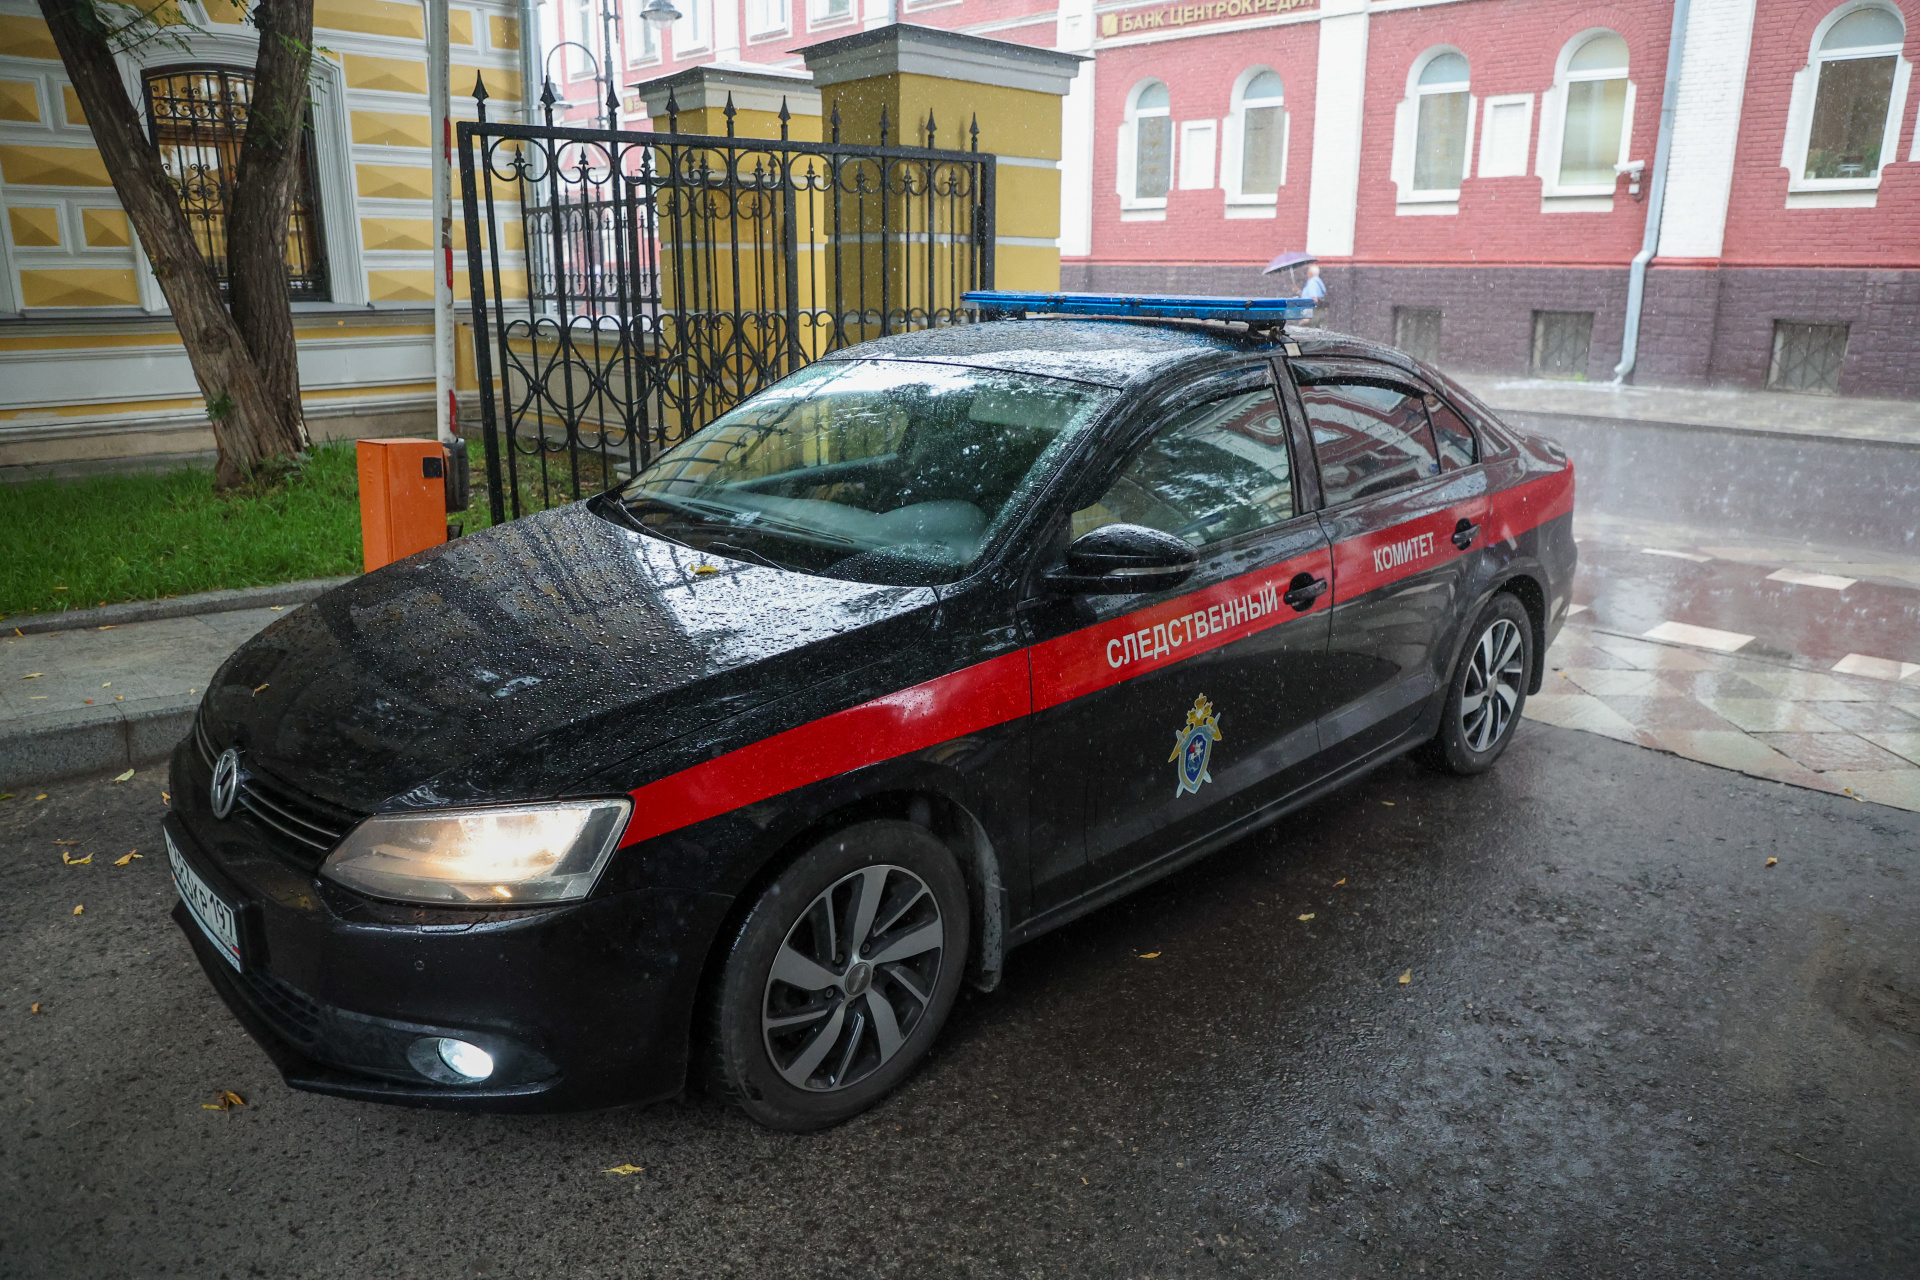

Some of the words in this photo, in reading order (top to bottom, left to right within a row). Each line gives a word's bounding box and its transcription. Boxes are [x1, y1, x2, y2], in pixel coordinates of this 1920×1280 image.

[1122, 12, 1165, 32] БАНК
[1373, 531, 1434, 573] КОМИТЕТ
[1106, 580, 1278, 668] СЛЕДСТВЕННЫЙ
[209, 893, 233, 938] 197
